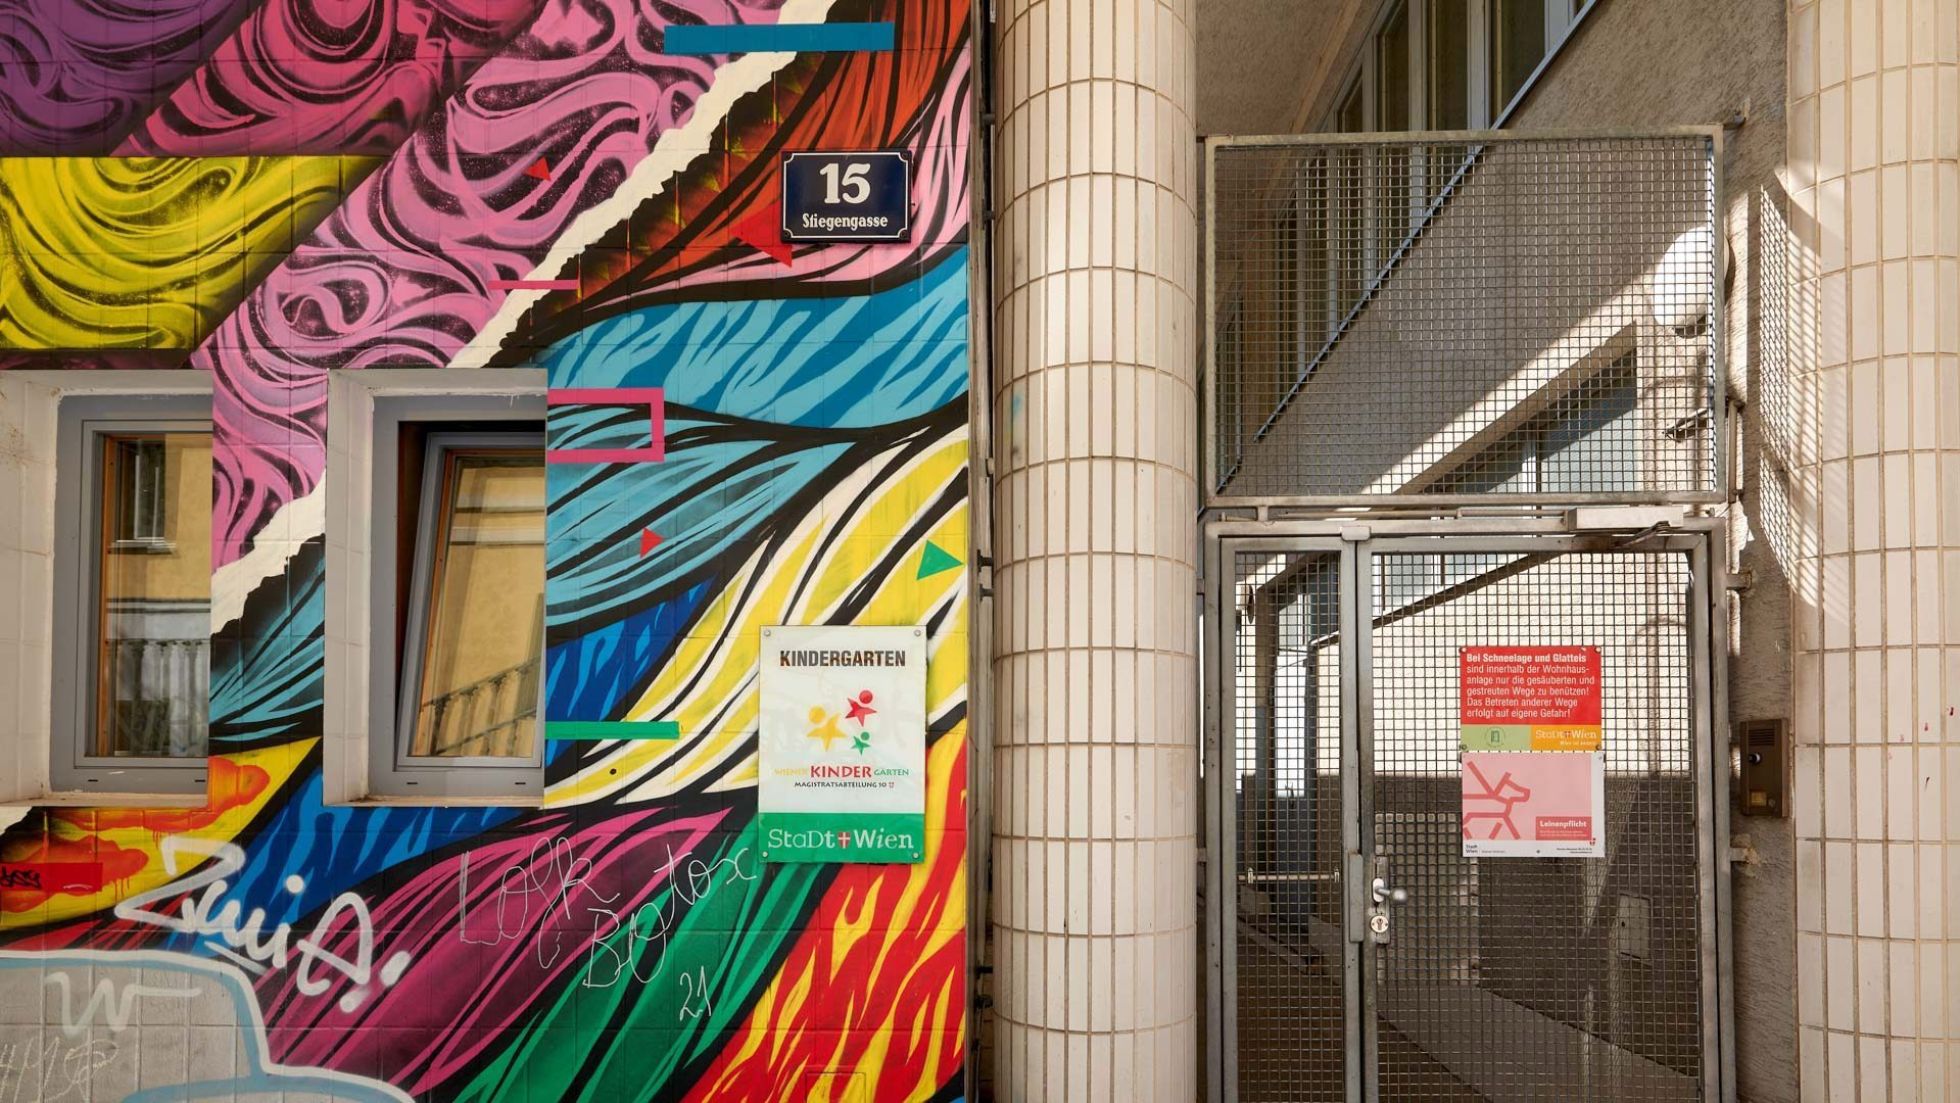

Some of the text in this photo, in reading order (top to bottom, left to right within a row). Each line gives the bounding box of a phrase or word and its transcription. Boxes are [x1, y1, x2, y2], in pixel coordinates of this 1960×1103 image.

[819, 162, 871, 204] 15
[802, 212, 889, 232] Stiegengasse
[780, 650, 906, 667] KINDERGARTEN
[1466, 653, 1587, 664] Bei Schneelage und Glatteis
[1466, 664, 1590, 673] sind innerhalb der Wohnhaus-
[1466, 675, 1493, 685] anlage
[1512, 675, 1524, 684] die
[1527, 675, 1577, 685] gesäuberten
[1579, 675, 1595, 684] und
[1466, 687, 1510, 696] gestreuten
[1512, 687, 1535, 697] Wege
[1549, 687, 1590, 695] benützen!
[1466, 698, 1578, 708] Das Betreten anderer Wege
[1466, 709, 1571, 719] erfolgt auf eigene Gefahr!
[810, 765, 872, 778] KINDER
[1539, 820, 1587, 829] Leinenpflicht
[854, 827, 914, 849] Wien
[679, 965, 712, 1022] 21
